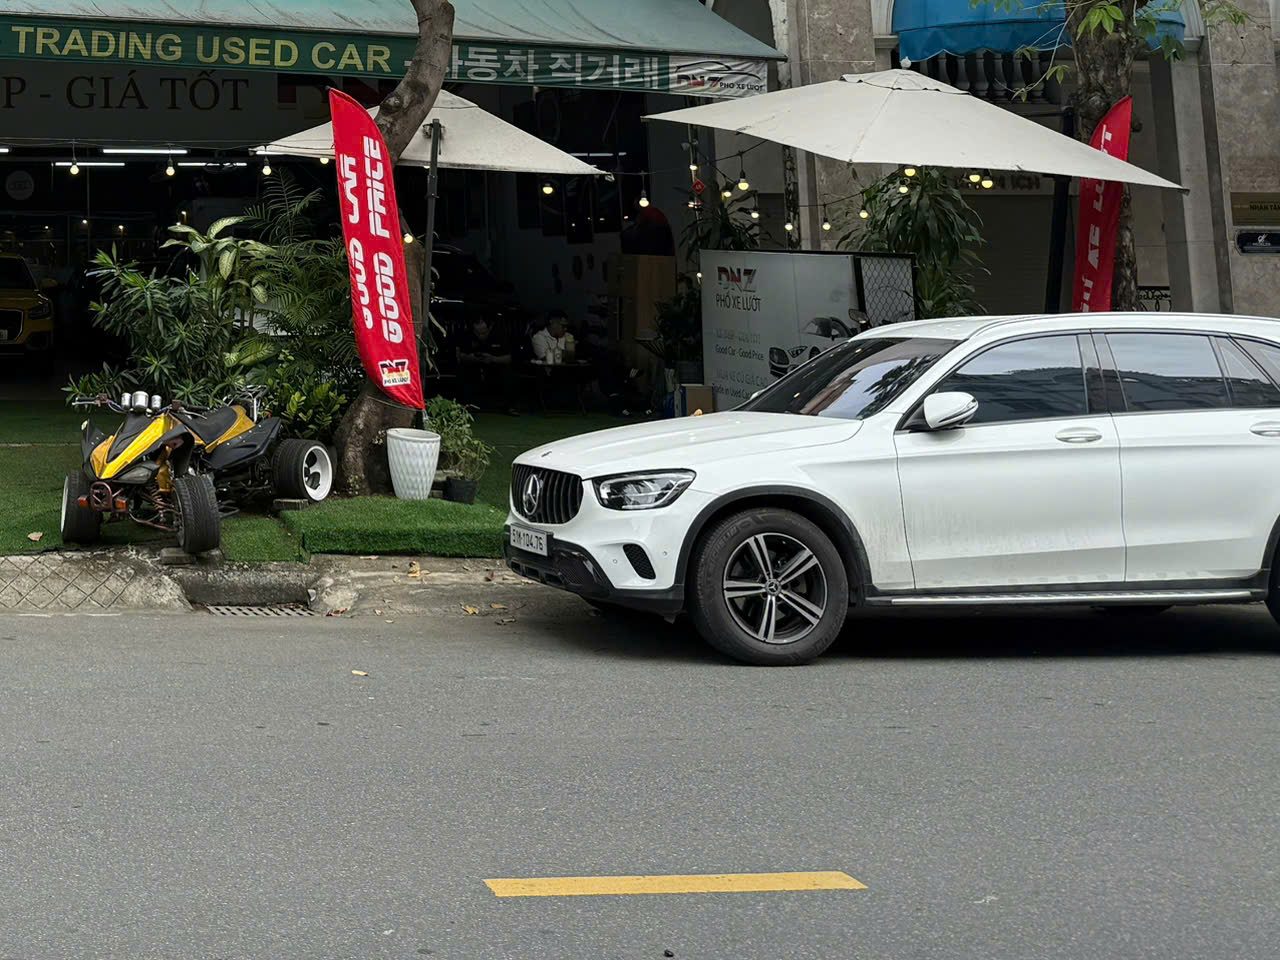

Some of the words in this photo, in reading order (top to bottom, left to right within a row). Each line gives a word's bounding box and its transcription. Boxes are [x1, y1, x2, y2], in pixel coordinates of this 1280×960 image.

[11, 25, 183, 62] TRADING
[196, 36, 300, 68] USED
[311, 41, 393, 73] CAR
[548, 52, 659, 90] 직거래
[66, 70, 150, 111] GIÁ
[160, 69, 249, 111] TỐT
[363, 135, 391, 239] PRICE
[349, 237, 373, 330] GOOD
[373, 252, 403, 344] GOOD
[731, 297, 742, 310] XE
